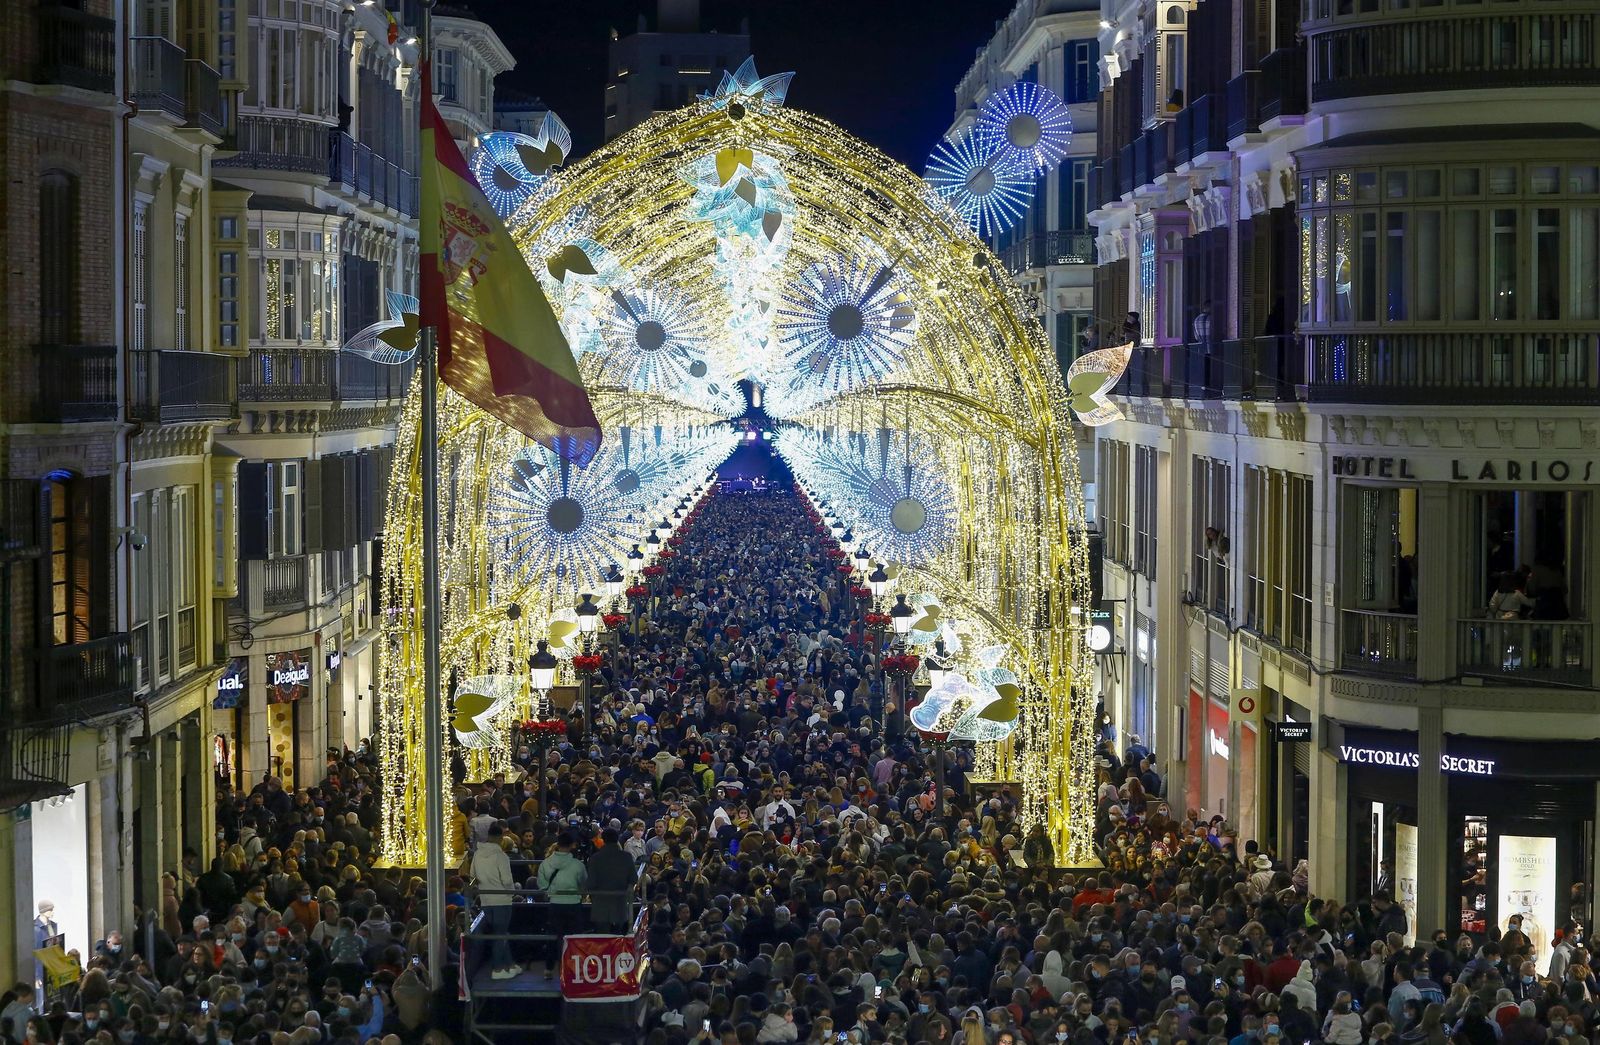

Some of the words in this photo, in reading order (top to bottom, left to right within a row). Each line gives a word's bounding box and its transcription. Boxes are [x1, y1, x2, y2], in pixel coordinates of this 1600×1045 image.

[1332, 456, 1415, 479] HOTEL
[1452, 460, 1593, 482] LARIOS
[1340, 745, 1420, 768] VICTORIA'S
[1441, 754, 1495, 775] SECRET
[571, 954, 615, 984] 101
[619, 957, 633, 969] tv
